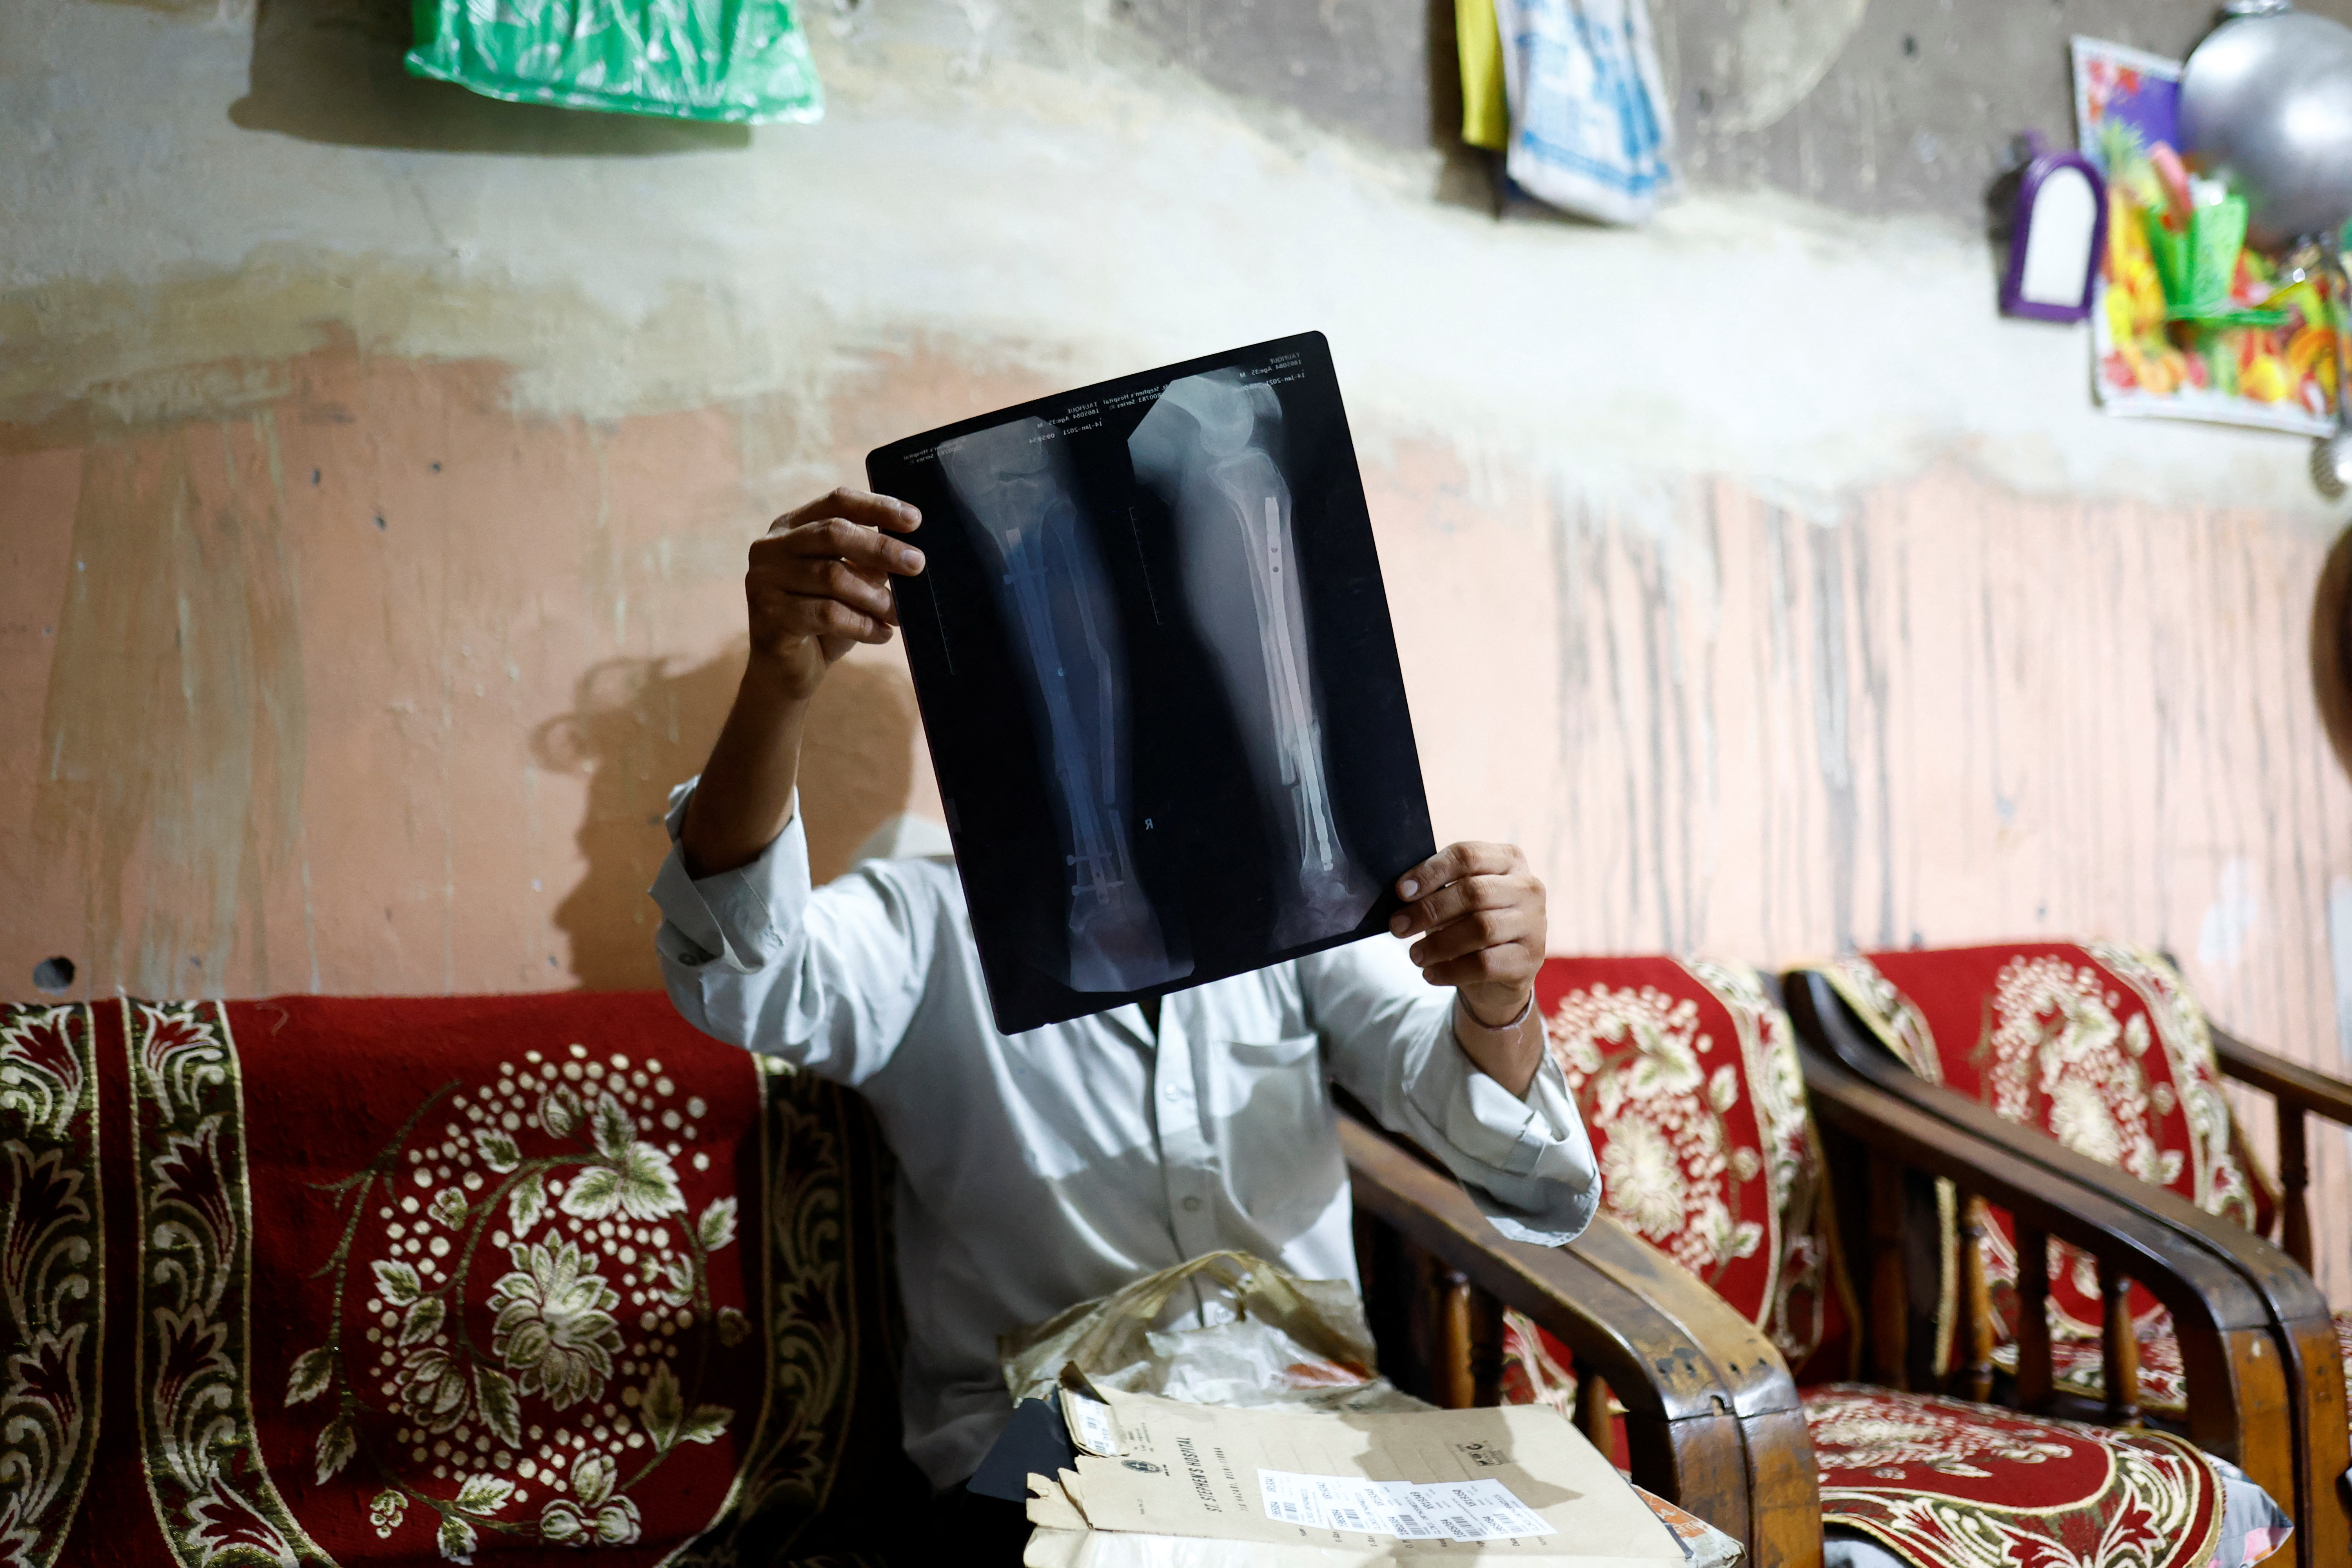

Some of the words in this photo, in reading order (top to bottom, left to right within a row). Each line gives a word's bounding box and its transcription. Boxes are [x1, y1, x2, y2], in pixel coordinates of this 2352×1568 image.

[1176, 1437, 1201, 1466] HOSPITAL
[1188, 1468, 1216, 1502] STEPHEN'S
[1204, 1503, 1222, 1512] ST.
[1270, 1501, 1283, 1518] 1865084
[1331, 1509, 1348, 1527] 1865084
[1387, 1516, 1409, 1535] 1865084
[1482, 1516, 1508, 1534] 1865084
[1440, 1519, 1466, 1537] 1865084
